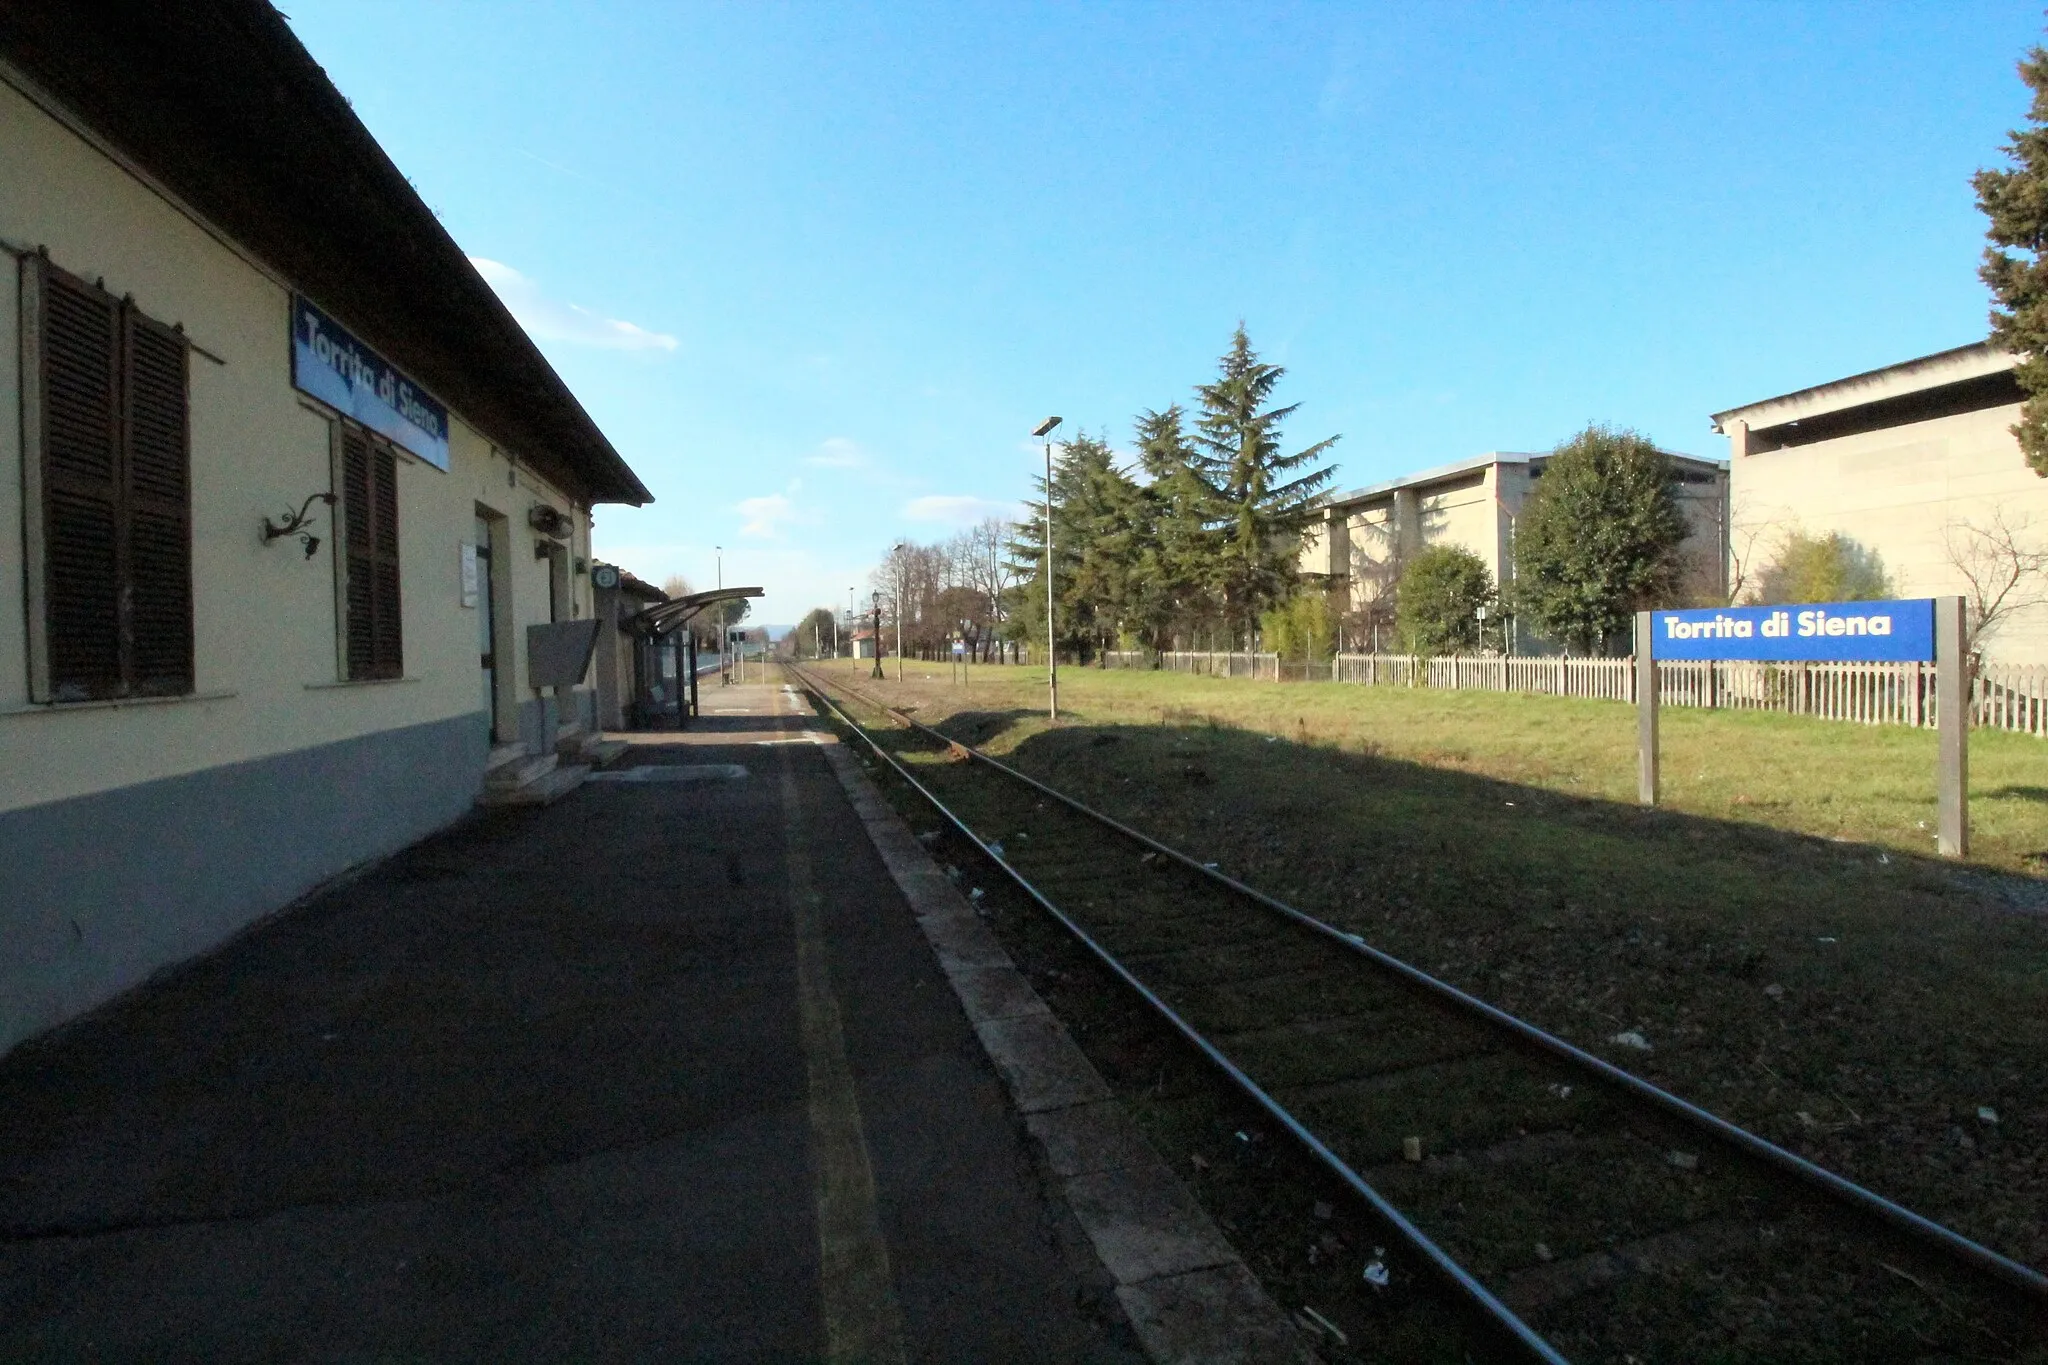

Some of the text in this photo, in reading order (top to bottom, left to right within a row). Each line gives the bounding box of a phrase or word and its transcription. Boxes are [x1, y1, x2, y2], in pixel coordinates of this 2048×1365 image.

[305, 311, 376, 394] Torrita
[400, 381, 440, 440] Siena
[1664, 610, 1891, 639] Torrita di Siena
